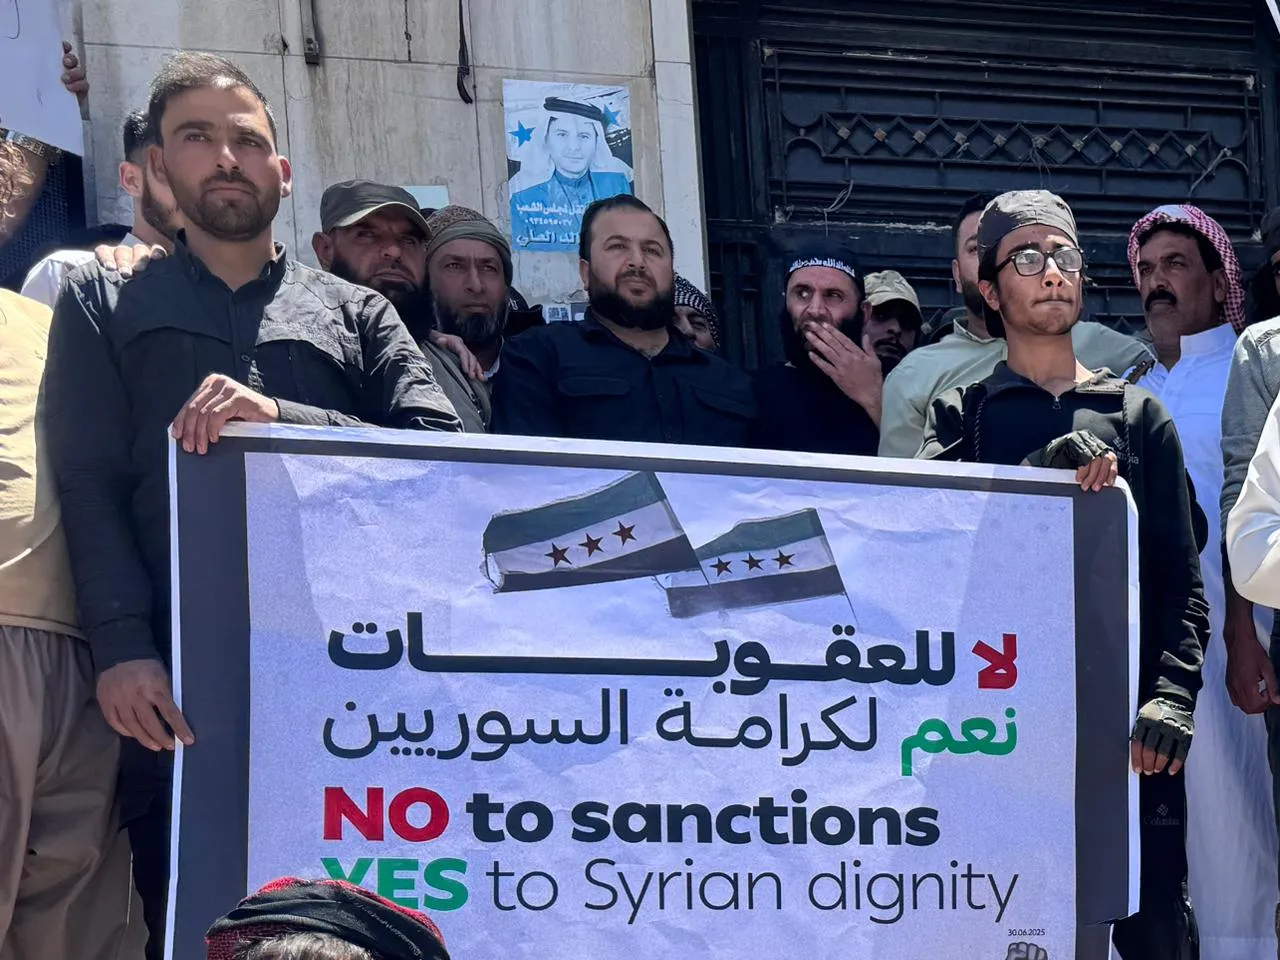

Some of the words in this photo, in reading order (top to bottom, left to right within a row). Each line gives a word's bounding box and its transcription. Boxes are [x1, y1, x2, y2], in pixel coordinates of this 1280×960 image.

[327, 611, 956, 696] للعقوبات
[971, 633, 1018, 690] لا
[323, 687, 629, 760] السوريين
[656, 688, 880, 767] لكرامة
[900, 708, 1018, 777] نعم
[323, 786, 450, 843] NO
[466, 792, 553, 844] to
[571, 788, 940, 847] sanctions
[320, 857, 469, 912] YES
[485, 860, 559, 912] to
[583, 857, 782, 925] Syrian
[807, 859, 1019, 925] dignity
